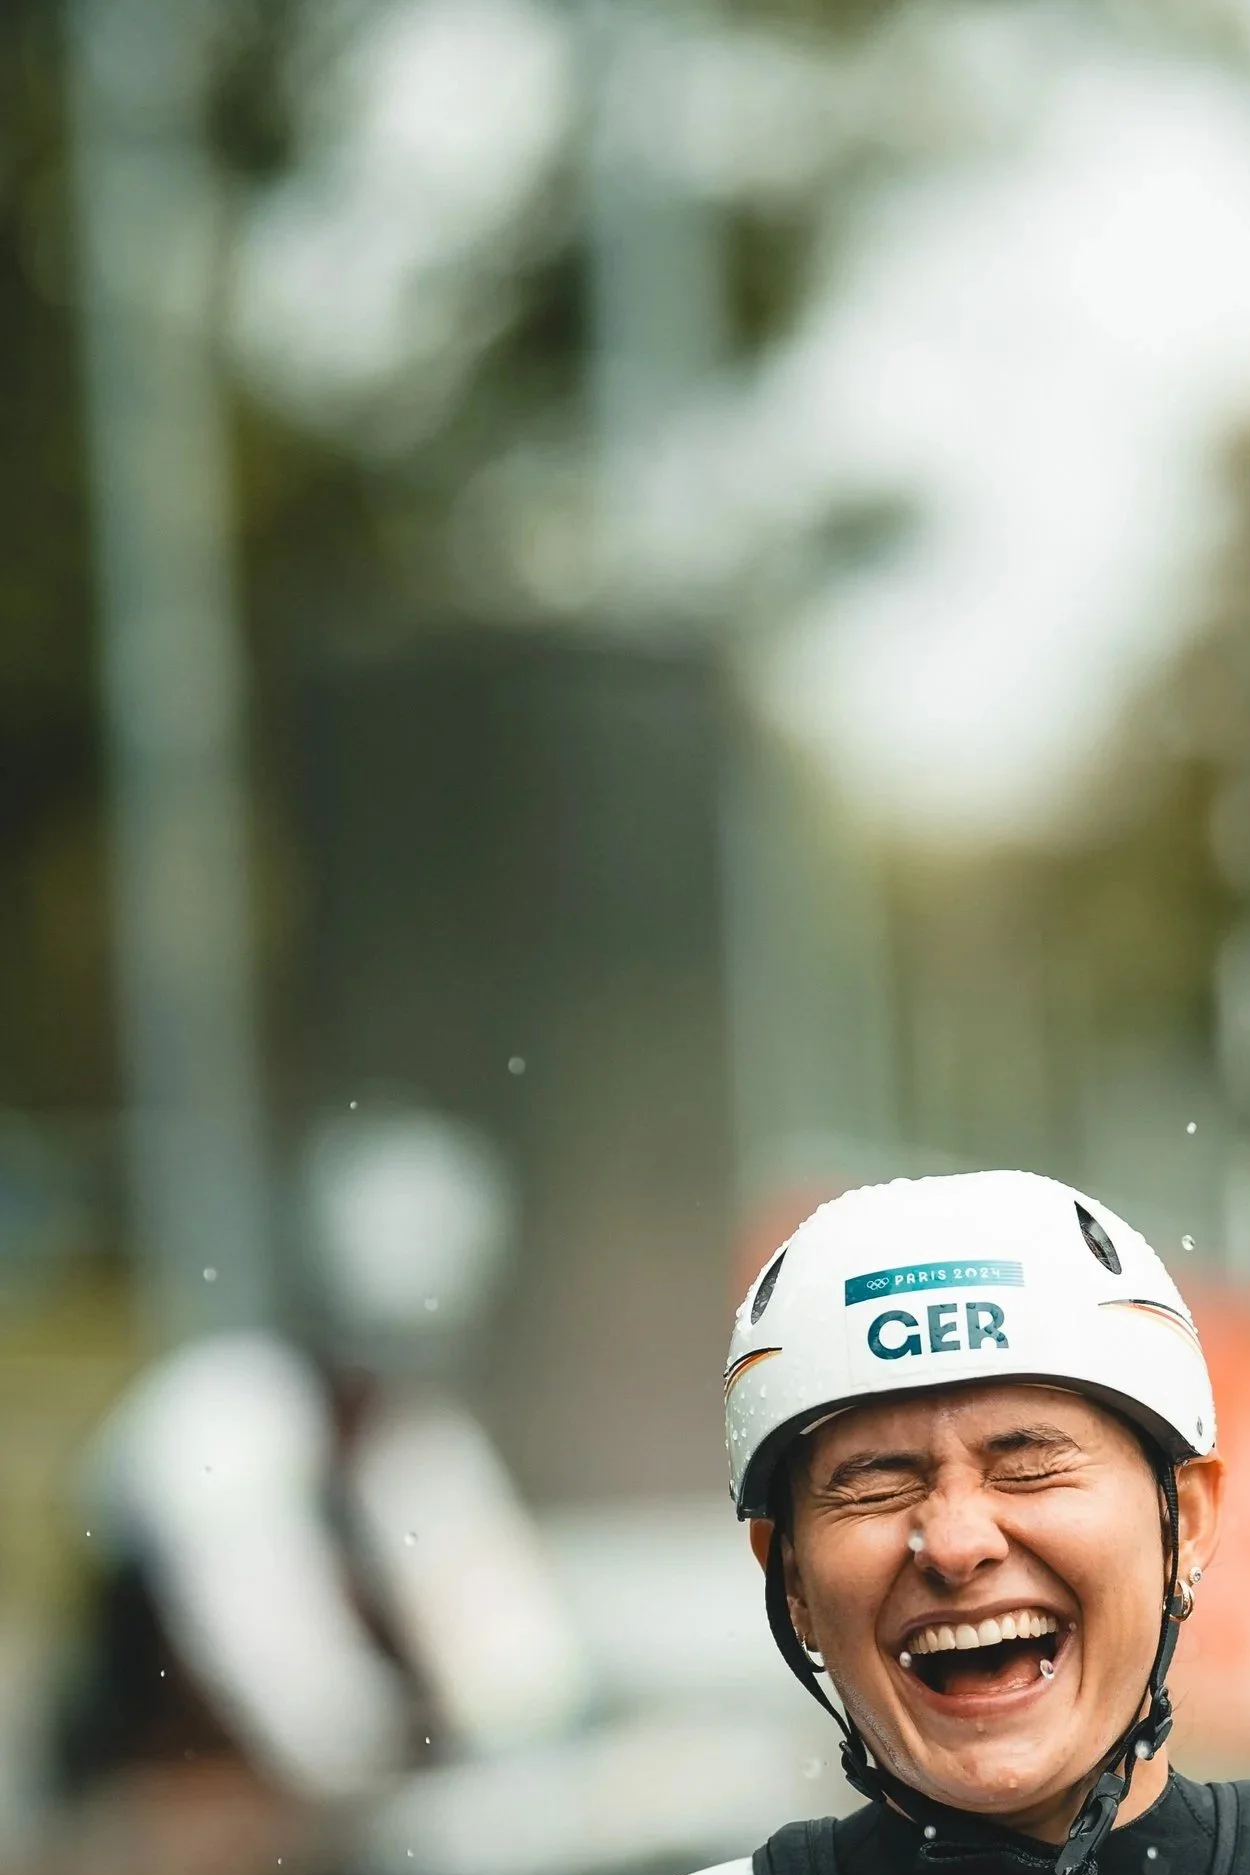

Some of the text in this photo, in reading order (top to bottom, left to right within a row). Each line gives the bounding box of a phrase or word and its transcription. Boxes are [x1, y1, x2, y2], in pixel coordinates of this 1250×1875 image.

[894, 1266, 1001, 1286] PARIS 2024
[867, 1301, 1010, 1360] GER
